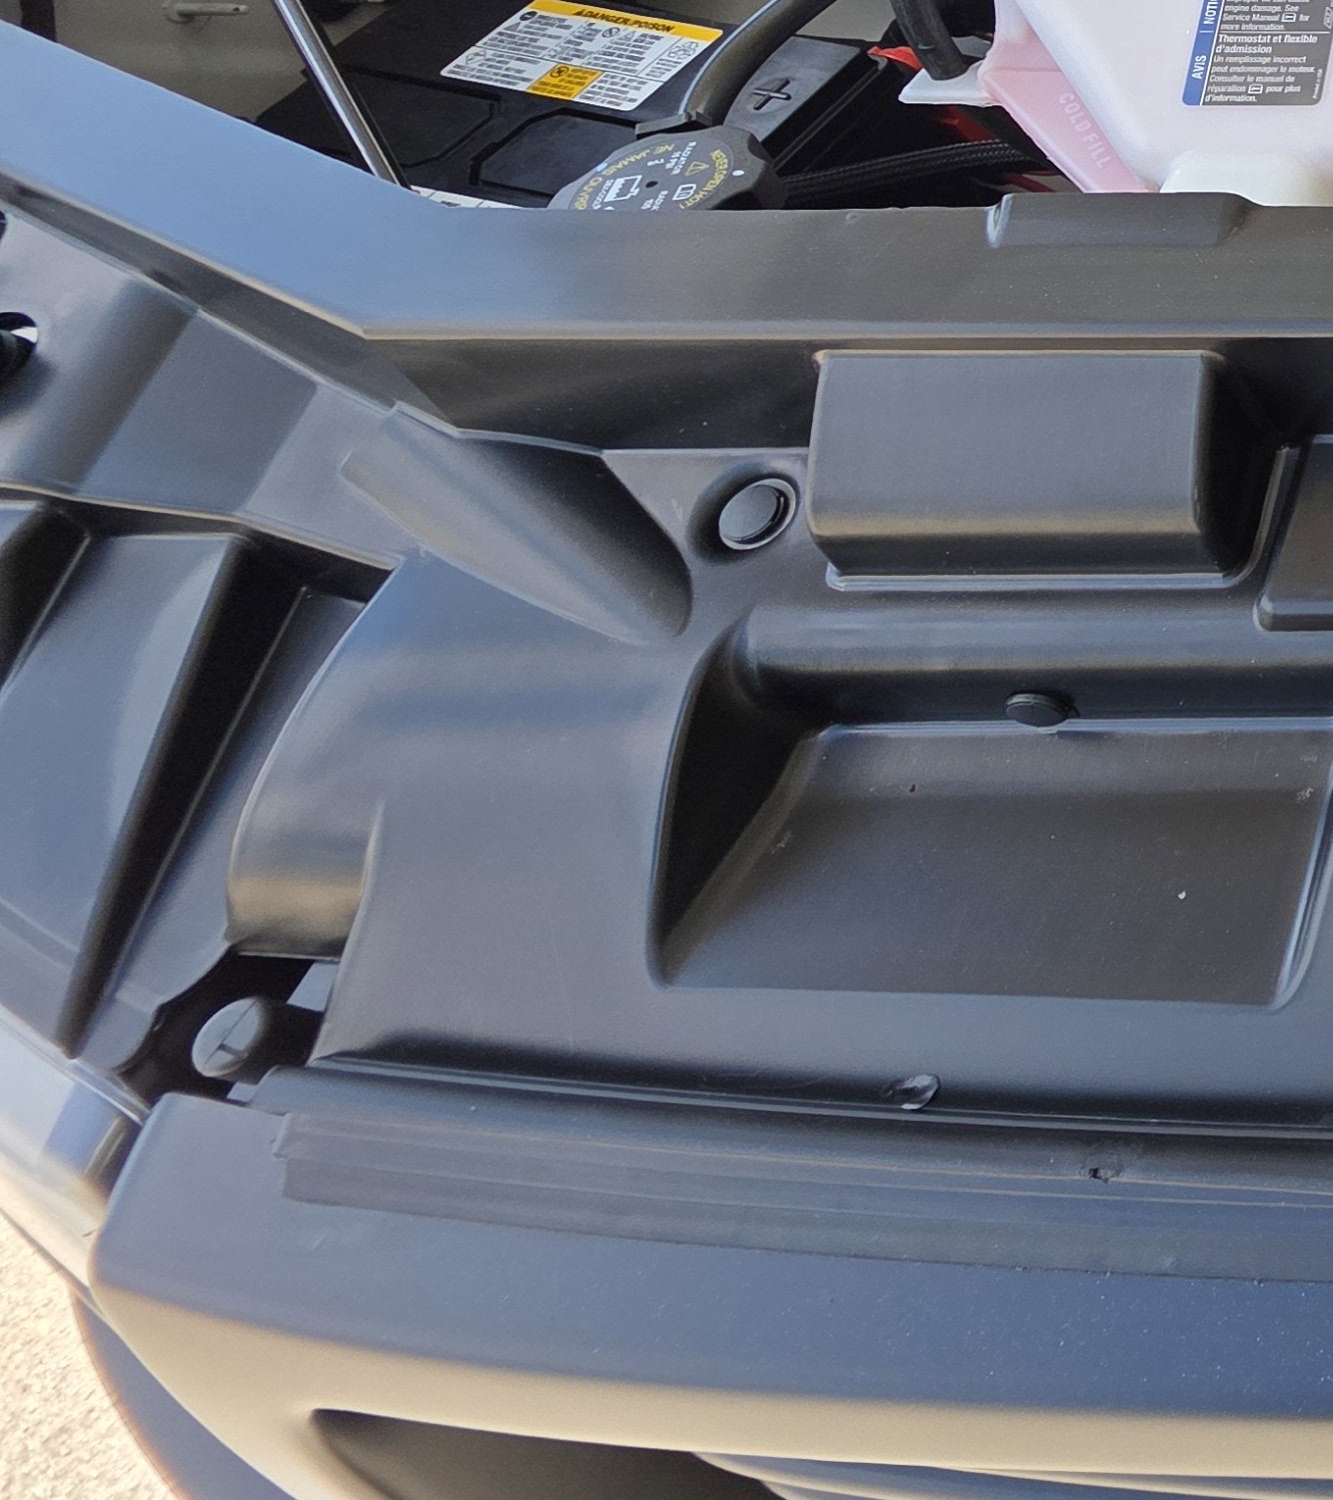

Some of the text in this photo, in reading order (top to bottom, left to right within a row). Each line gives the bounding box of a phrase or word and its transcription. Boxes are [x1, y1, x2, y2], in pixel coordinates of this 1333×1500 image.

[1218, 34, 1318, 44] Thermostat et flexible
[1215, 44, 1273, 54] d'admission
[1191, 55, 1207, 80] AVIS
[1058, 92, 1112, 169] COLD FILL
[653, 143, 676, 155] NE
[603, 150, 651, 177] JAMAIS
